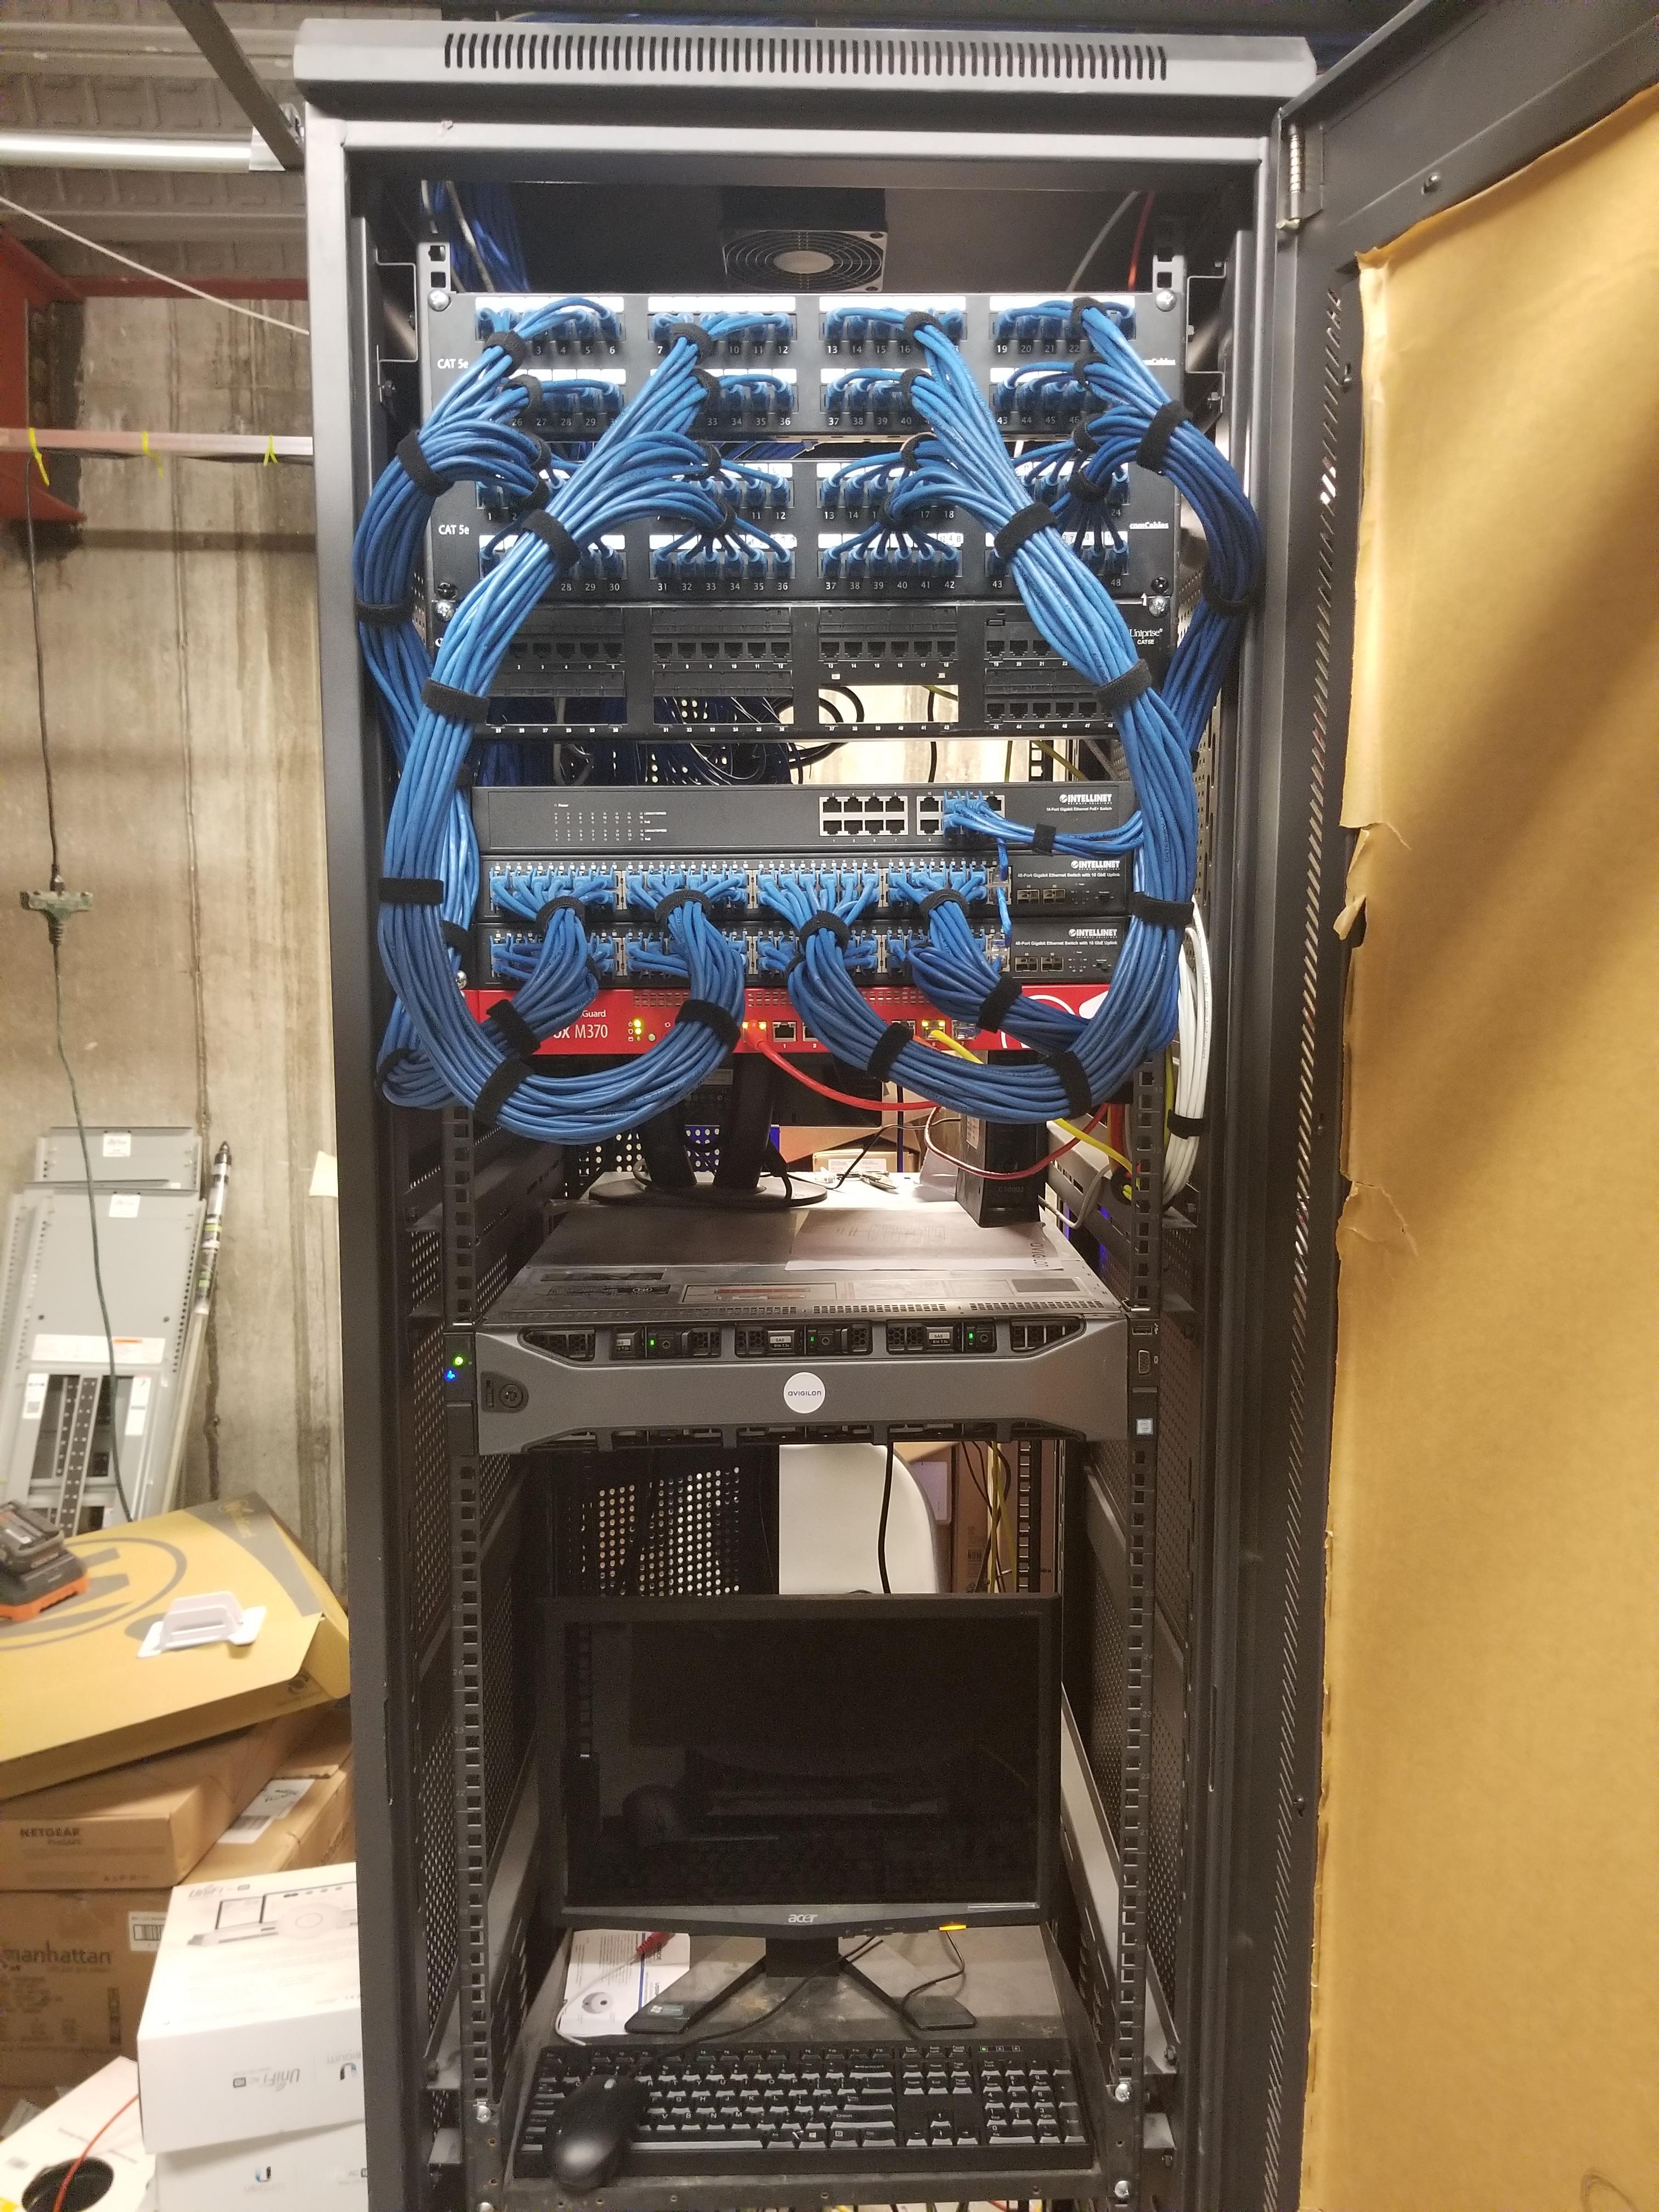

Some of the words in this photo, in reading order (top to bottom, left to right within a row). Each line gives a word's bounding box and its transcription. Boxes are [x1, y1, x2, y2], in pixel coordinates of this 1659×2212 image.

[437, 358, 456, 369] CAT
[458, 358, 469, 369] 5e
[438, 524, 457, 535] CAT
[459, 524, 470, 535] 5e
[1129, 521, 1169, 529] comCables
[1068, 794, 1112, 803] INTELLINET
[1079, 860, 1120, 868] INTELLINET
[582, 1009, 607, 1018] Guard
[574, 1024, 608, 1039] M370
[788, 1914, 818, 1923] acer
